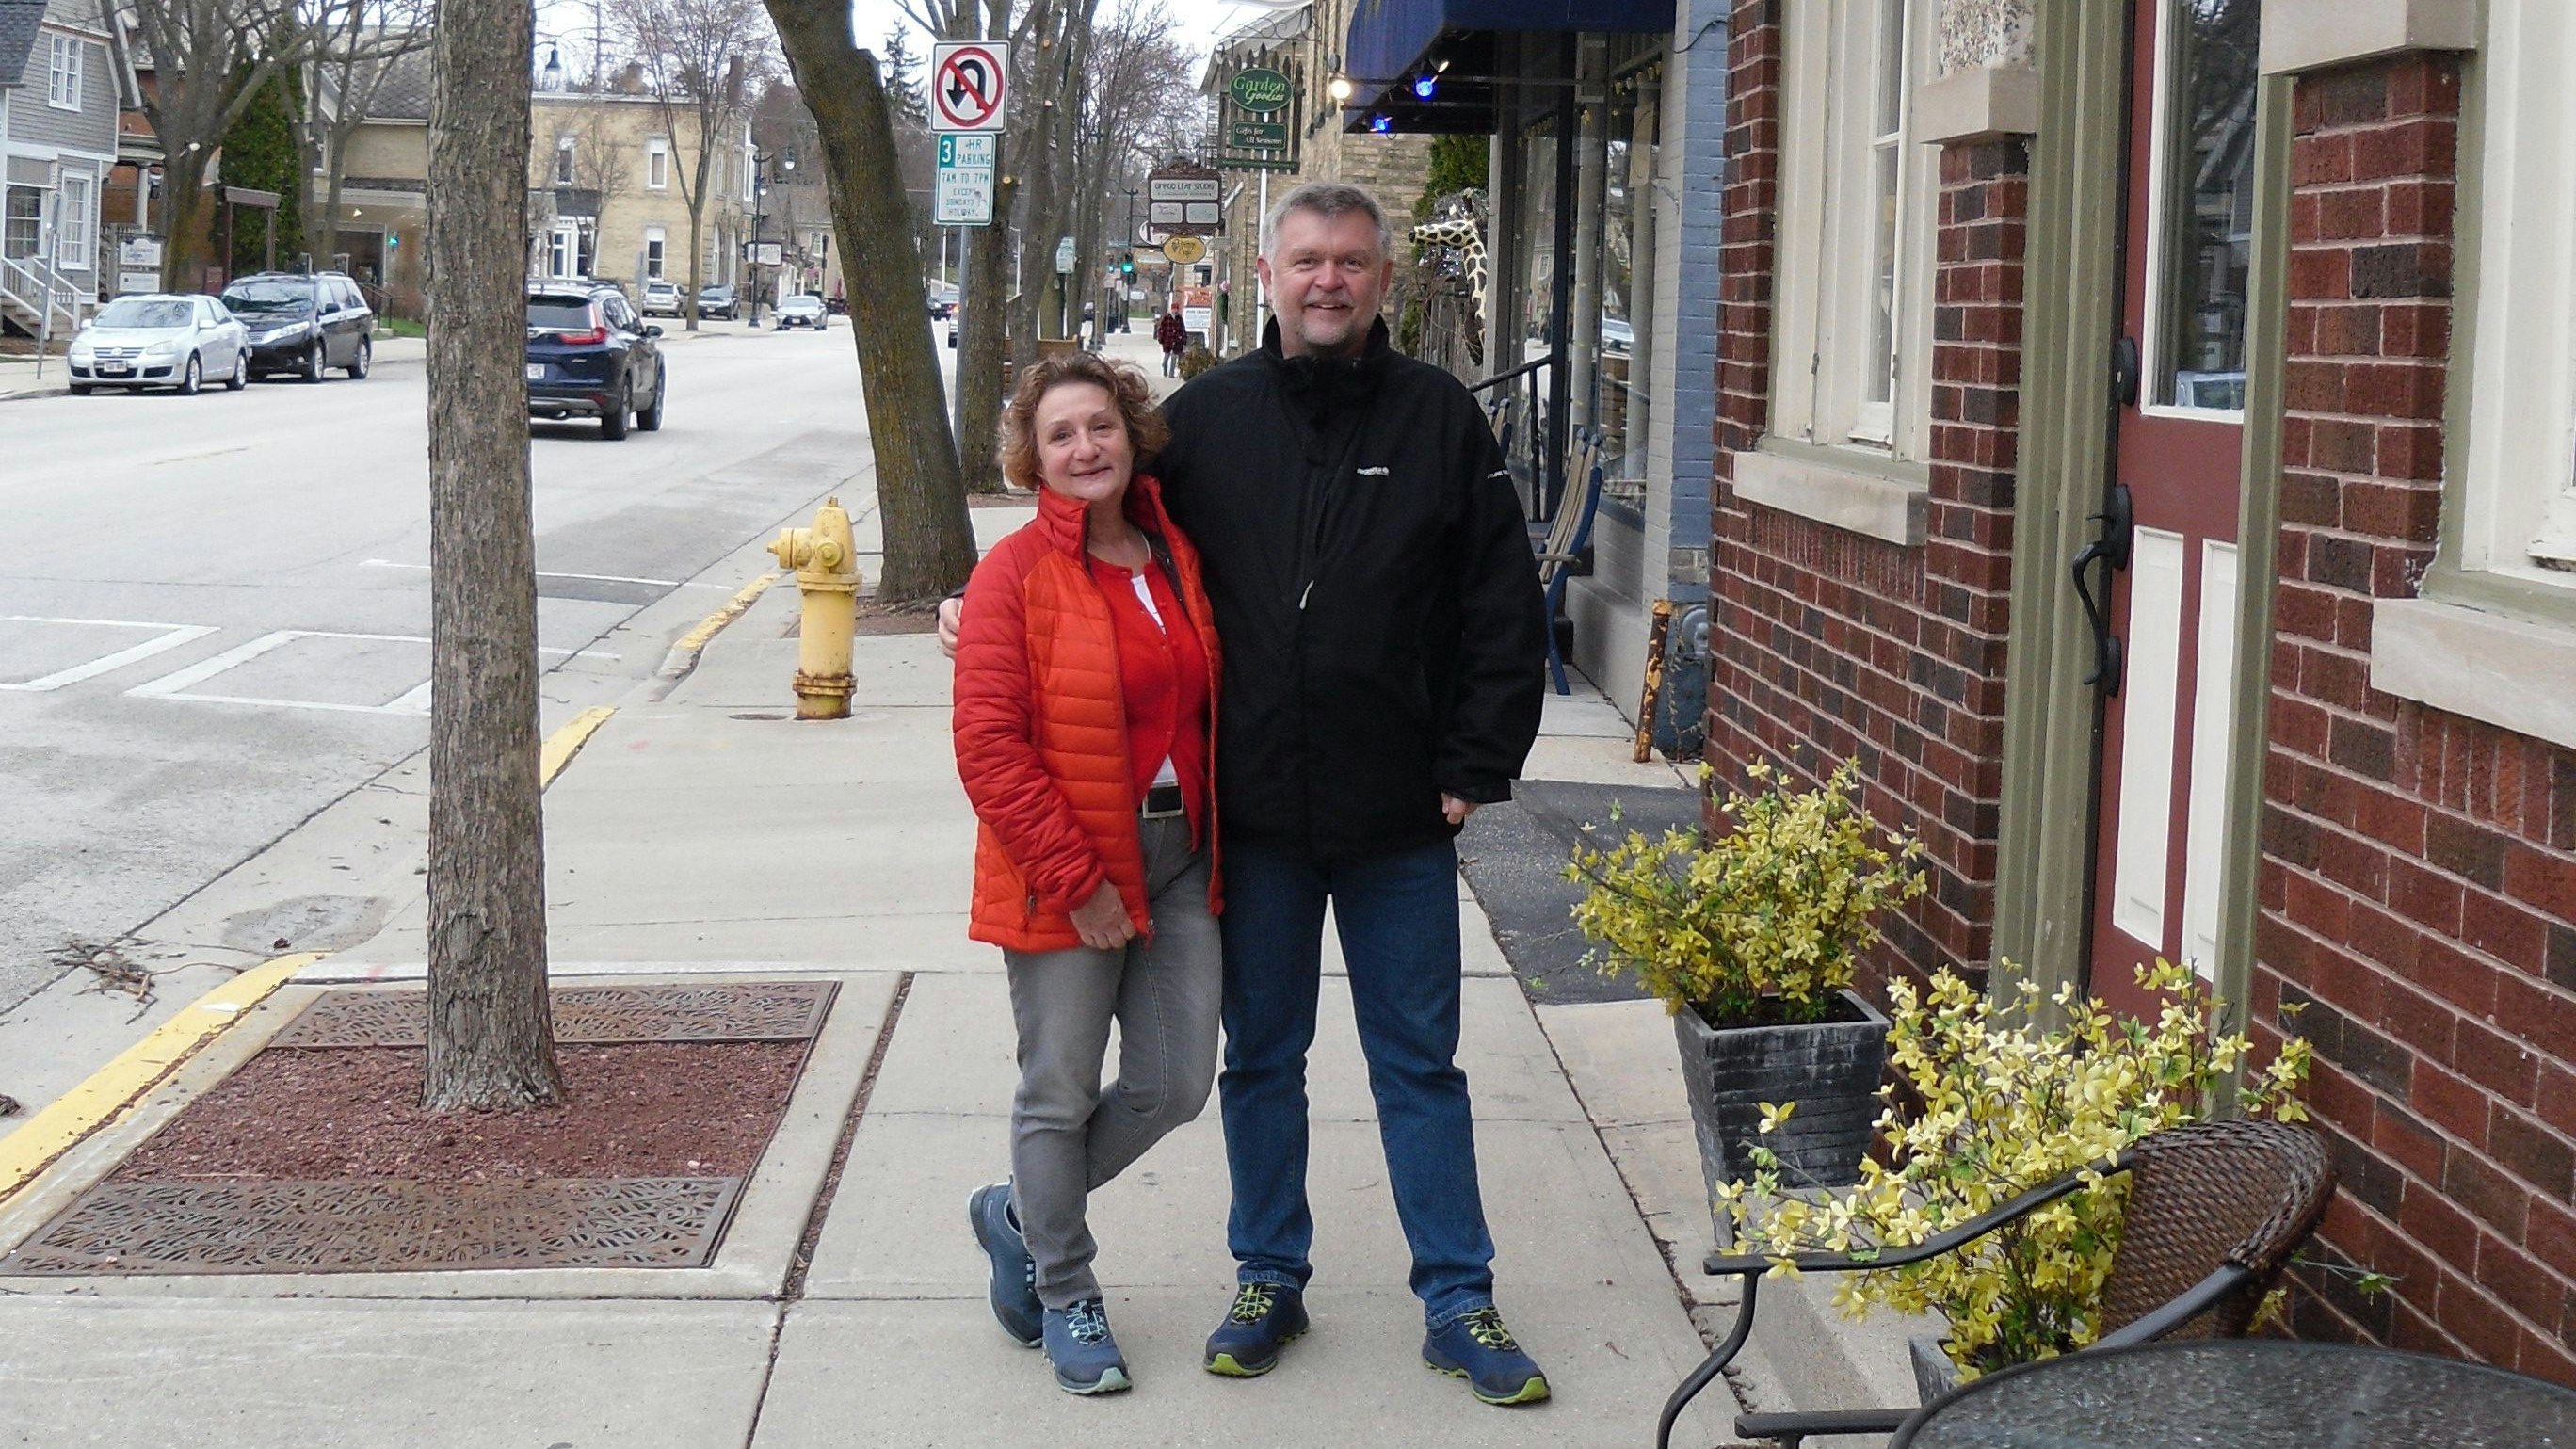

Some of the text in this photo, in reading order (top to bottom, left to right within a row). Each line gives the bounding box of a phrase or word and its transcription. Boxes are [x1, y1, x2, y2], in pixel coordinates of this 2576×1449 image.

[1233, 76, 1286, 91] Garden
[1245, 87, 1285, 105] Goodies
[1253, 126, 1264, 136] for
[942, 139, 952, 163] 3
[957, 153, 990, 165] PARKING
[942, 172, 990, 185] 7AM TO 7PM
